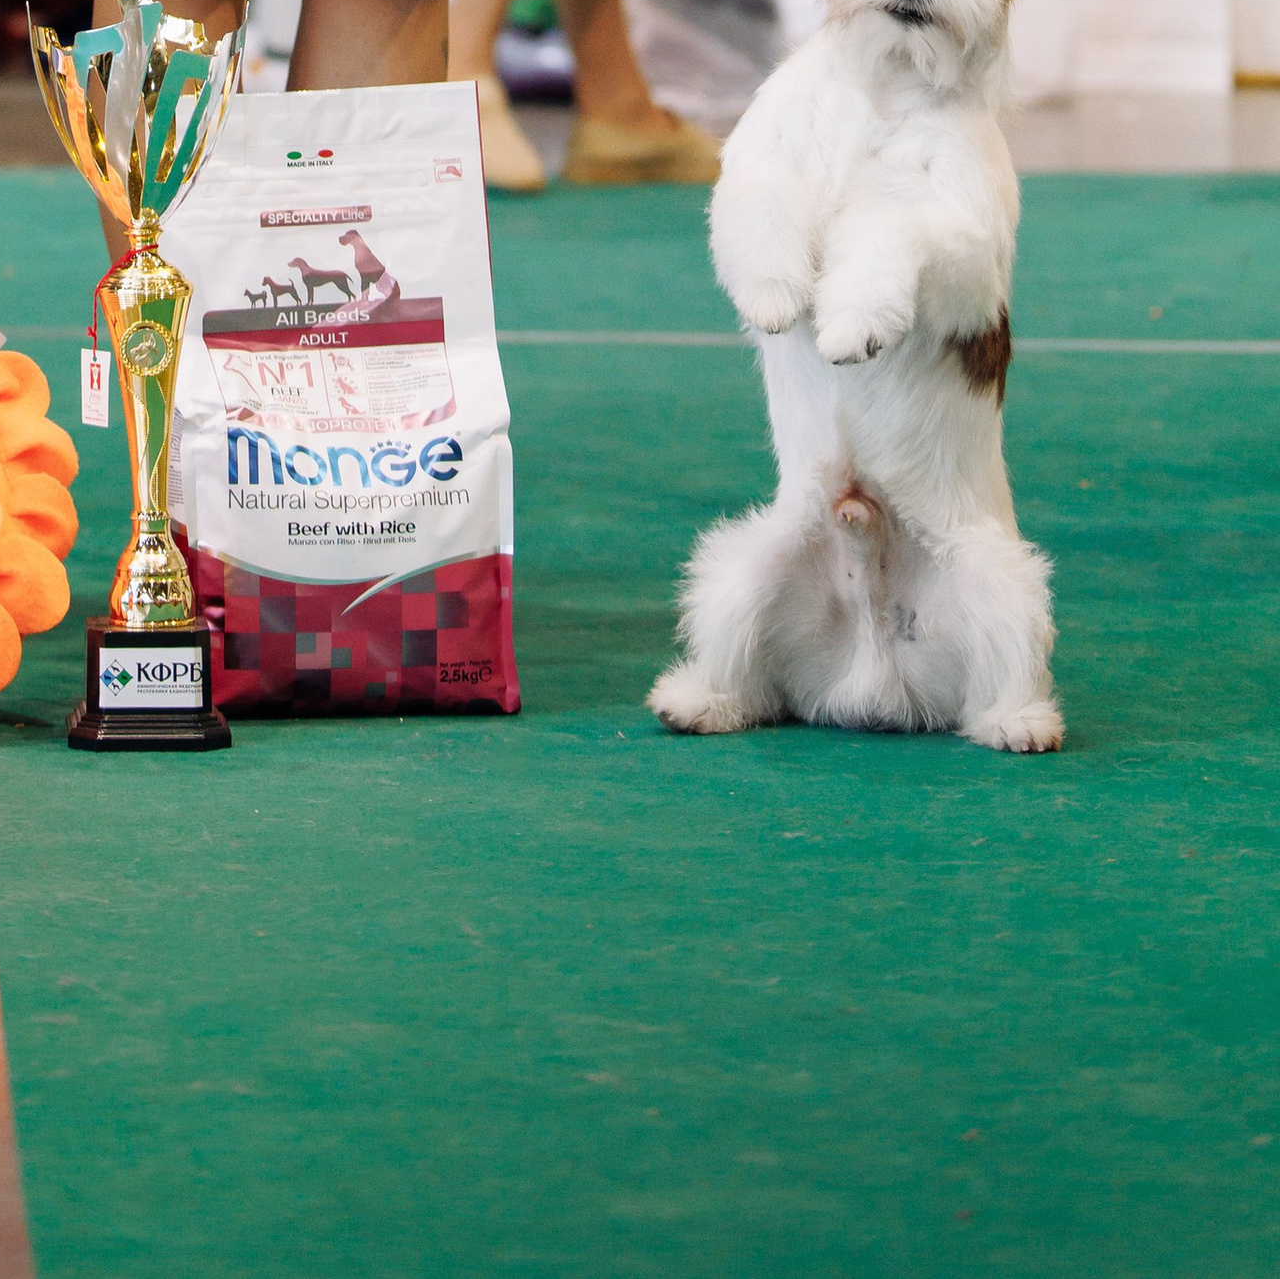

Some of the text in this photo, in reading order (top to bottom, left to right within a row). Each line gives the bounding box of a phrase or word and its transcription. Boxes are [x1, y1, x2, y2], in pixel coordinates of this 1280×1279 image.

[316, 159, 334, 167] ITALY
[268, 210, 365, 225] SPECIALITY Line
[275, 308, 370, 326] All Breeds
[299, 332, 348, 346] ADULT
[228, 485, 470, 514] Natural Superpremium
[288, 520, 416, 536] Beef with Rice
[288, 538, 317, 546] Manzo
[336, 537, 356, 546] Riso
[136, 662, 203, 683] КФРБ
